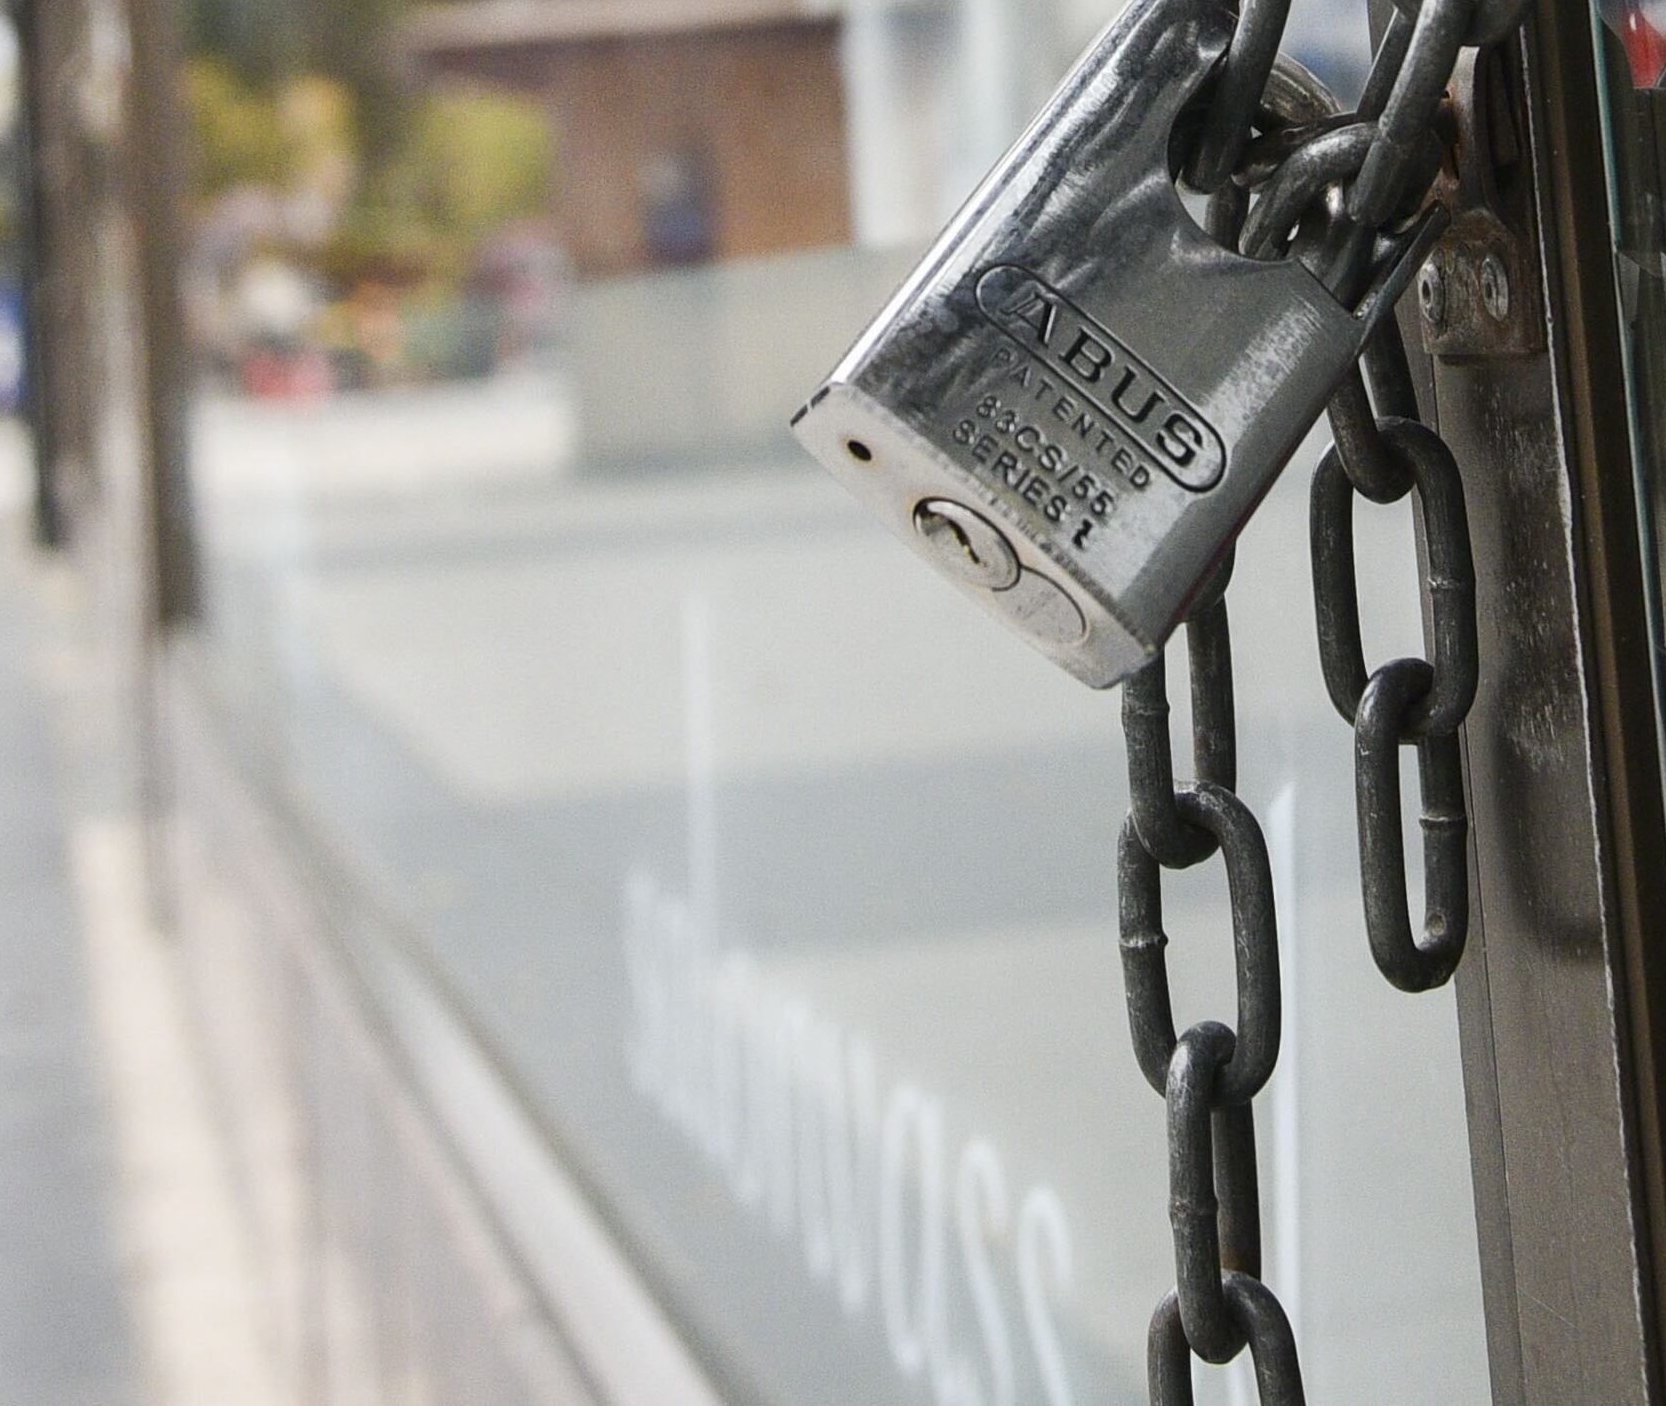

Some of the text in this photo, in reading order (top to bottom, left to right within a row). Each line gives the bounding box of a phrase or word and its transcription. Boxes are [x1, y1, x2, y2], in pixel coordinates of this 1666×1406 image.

[989, 349, 1153, 491] PATENTED
[1002, 287, 1205, 468] ABUS
[953, 419, 1071, 522] SERIES
[976, 395, 1116, 518] 83CS/55
